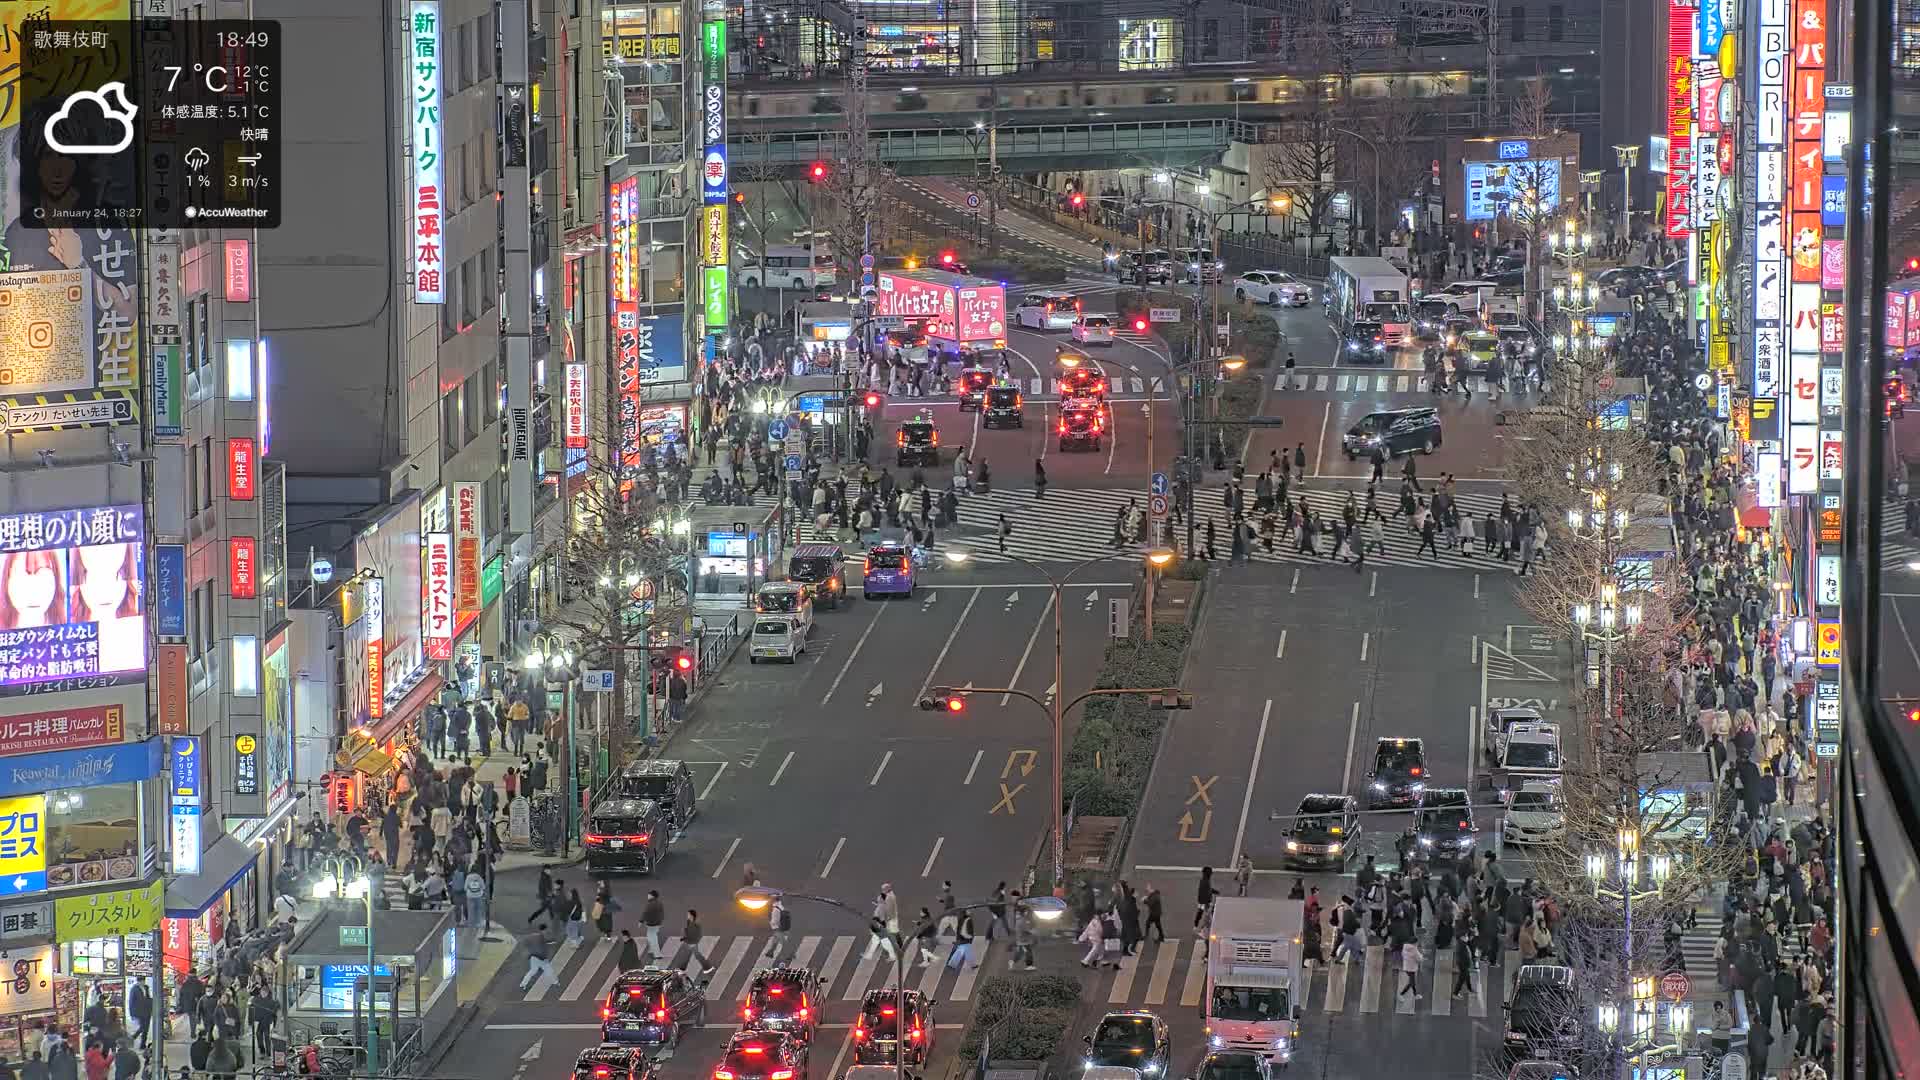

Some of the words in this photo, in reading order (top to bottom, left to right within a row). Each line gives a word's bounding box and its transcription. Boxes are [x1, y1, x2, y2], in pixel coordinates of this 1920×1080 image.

[414, 12, 438, 171] 新宿サンパーク
[1704, 88, 1717, 121] アコム
[707, 86, 721, 139] もつなべ
[705, 161, 724, 178] 薬
[417, 185, 440, 293] 三平本館
[709, 209, 722, 263] 肉汁水餃子
[709, 276, 722, 314] レイク
[964, 299, 998, 312] バイトな
[157, 326, 174, 334] 3F
[1758, 331, 1772, 383] 大衆酒場
[157, 354, 168, 415] FamilyMart
[1794, 309, 1818, 470] パセラ
[13, 411, 48, 423] テンクリ
[53, 404, 110, 420] たいせい先生
[513, 408, 529, 461] HOMEGAME
[234, 451, 248, 489] 龍生堂
[459, 487, 471, 532] GAME
[1826, 498, 1837, 507] 3F
[0, 508, 137, 549] 理想の小顔に
[236, 548, 249, 584] 龍生堂
[431, 543, 448, 629] 三平ストア
[0, 717, 68, 740] ルコ料理
[24, 736, 68, 748] RESTAURANT
[0, 812, 38, 837] プロ
[0, 837, 39, 859] ミス
[3, 912, 38, 932] 囲碁
[69, 904, 141, 928] クリスタル
[327, 991, 341, 1005] 12
